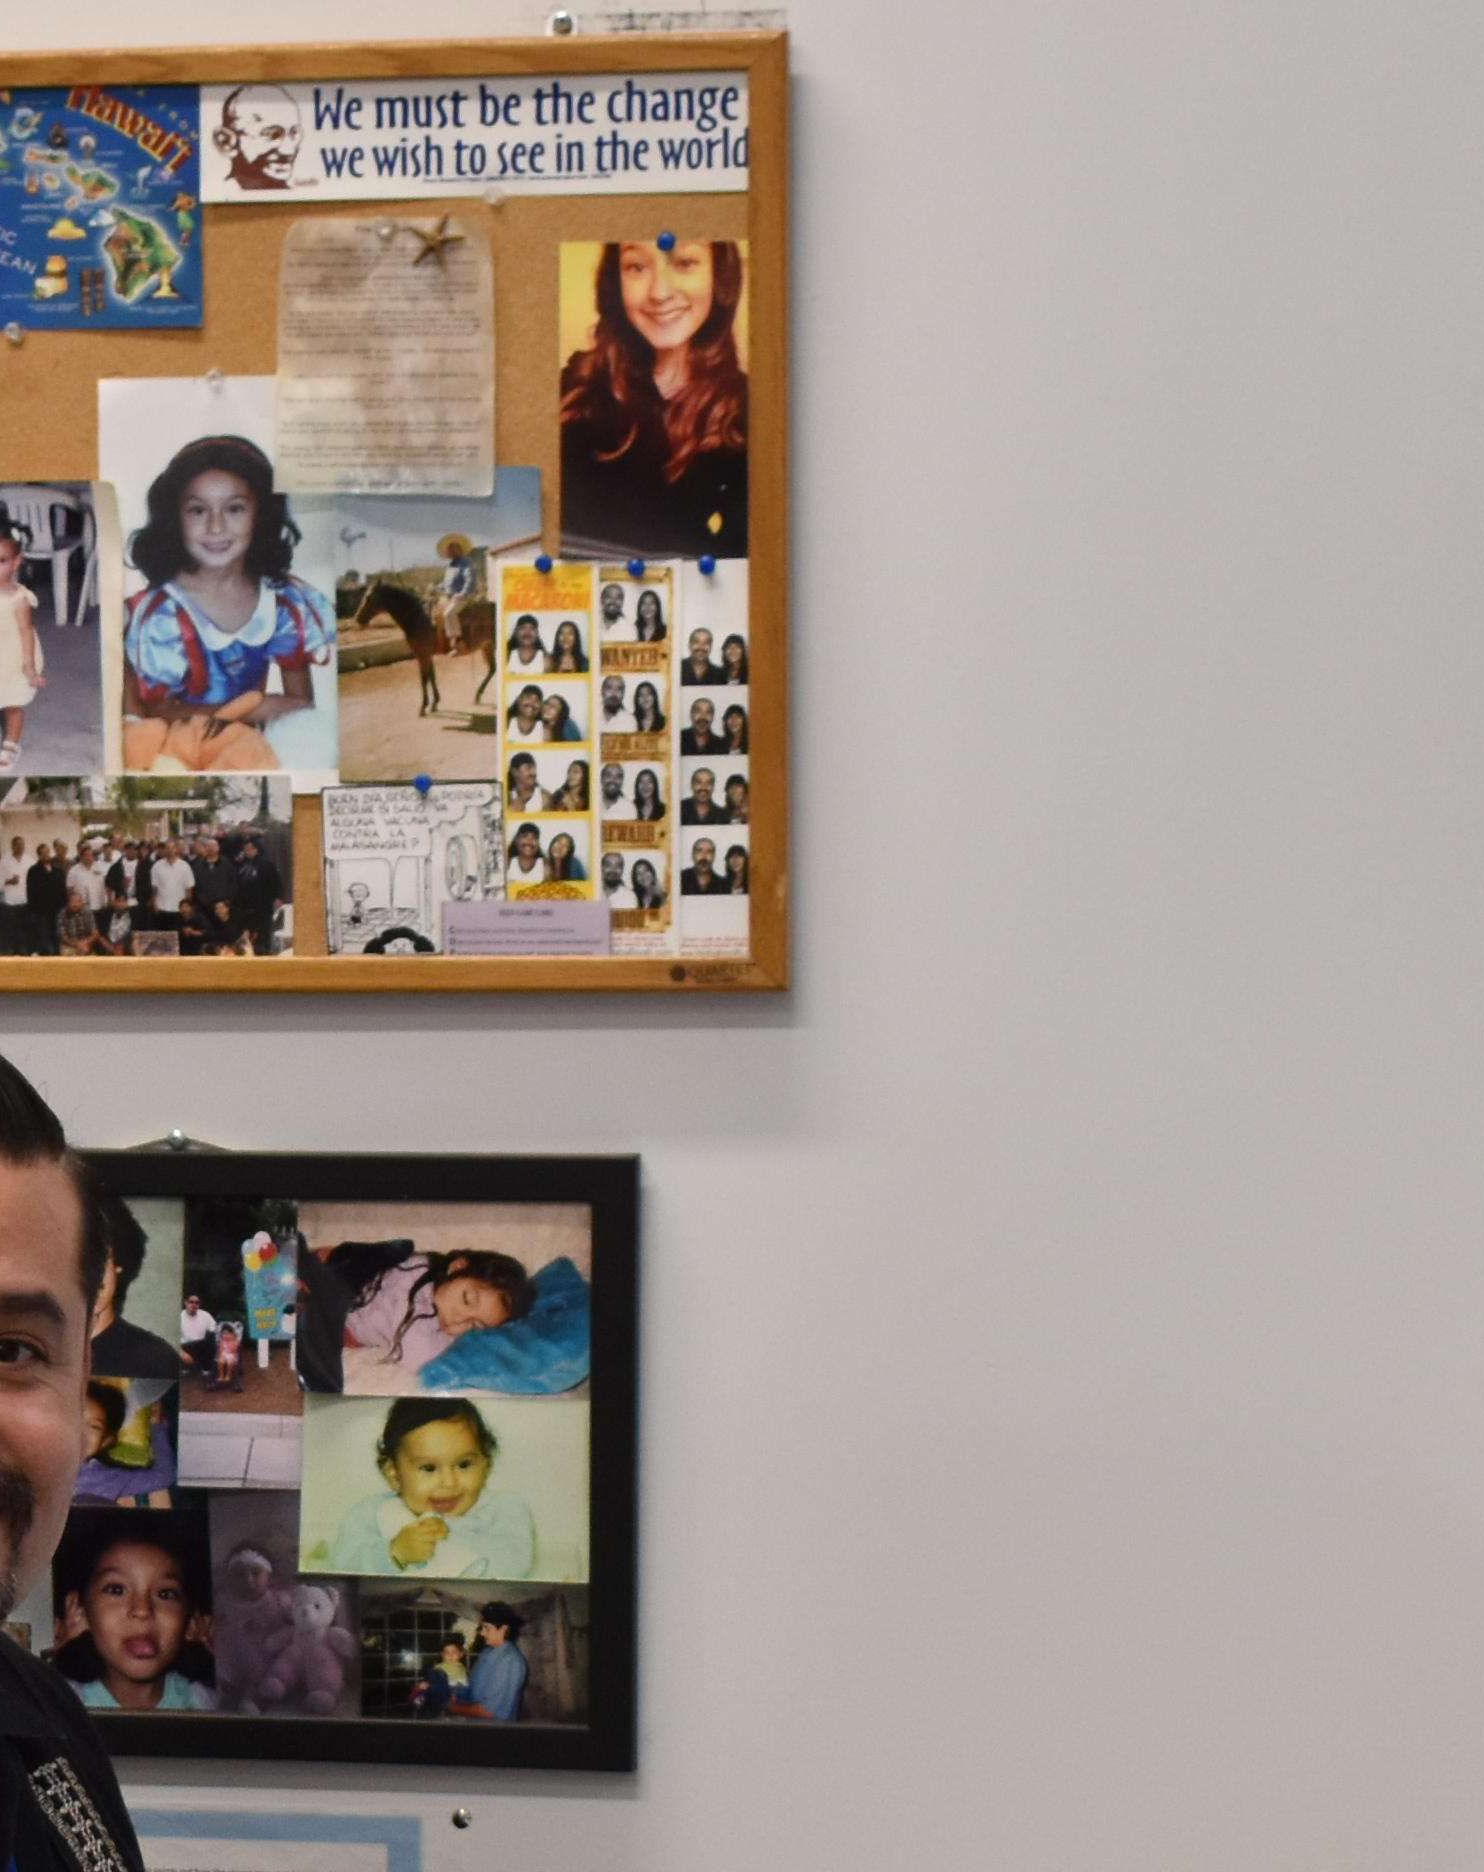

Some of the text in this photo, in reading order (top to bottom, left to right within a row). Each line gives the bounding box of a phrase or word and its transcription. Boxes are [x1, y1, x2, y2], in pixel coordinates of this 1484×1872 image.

[313, 79, 740, 133] We must be the change
[320, 126, 749, 179] we wish to see in the world
